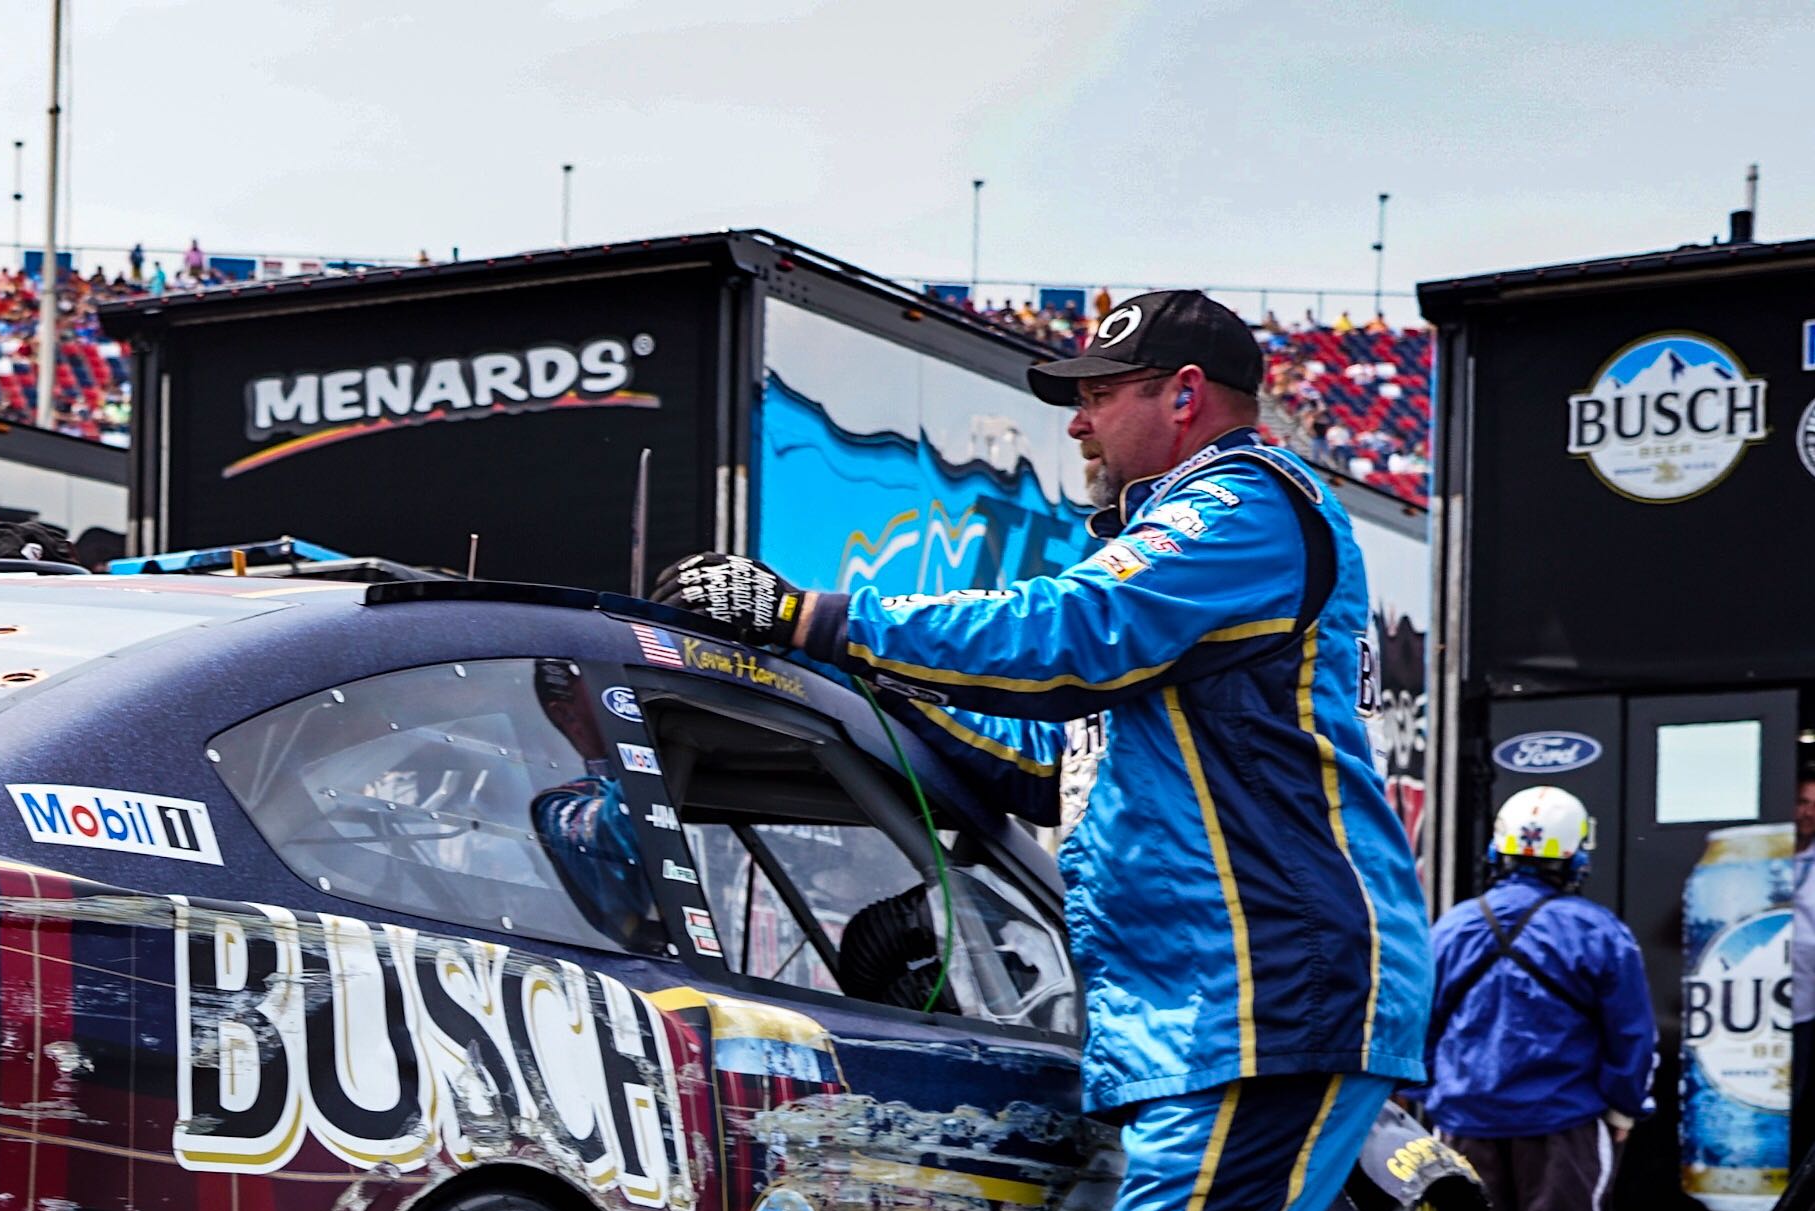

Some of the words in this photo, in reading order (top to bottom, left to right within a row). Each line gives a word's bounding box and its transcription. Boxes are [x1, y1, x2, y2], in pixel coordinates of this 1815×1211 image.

[254, 339, 628, 428] MENARDS
[1570, 380, 1766, 451] BUSCH
[1512, 737, 1582, 767] Ford
[20, 792, 156, 846] Mobil
[158, 804, 202, 852] 1
